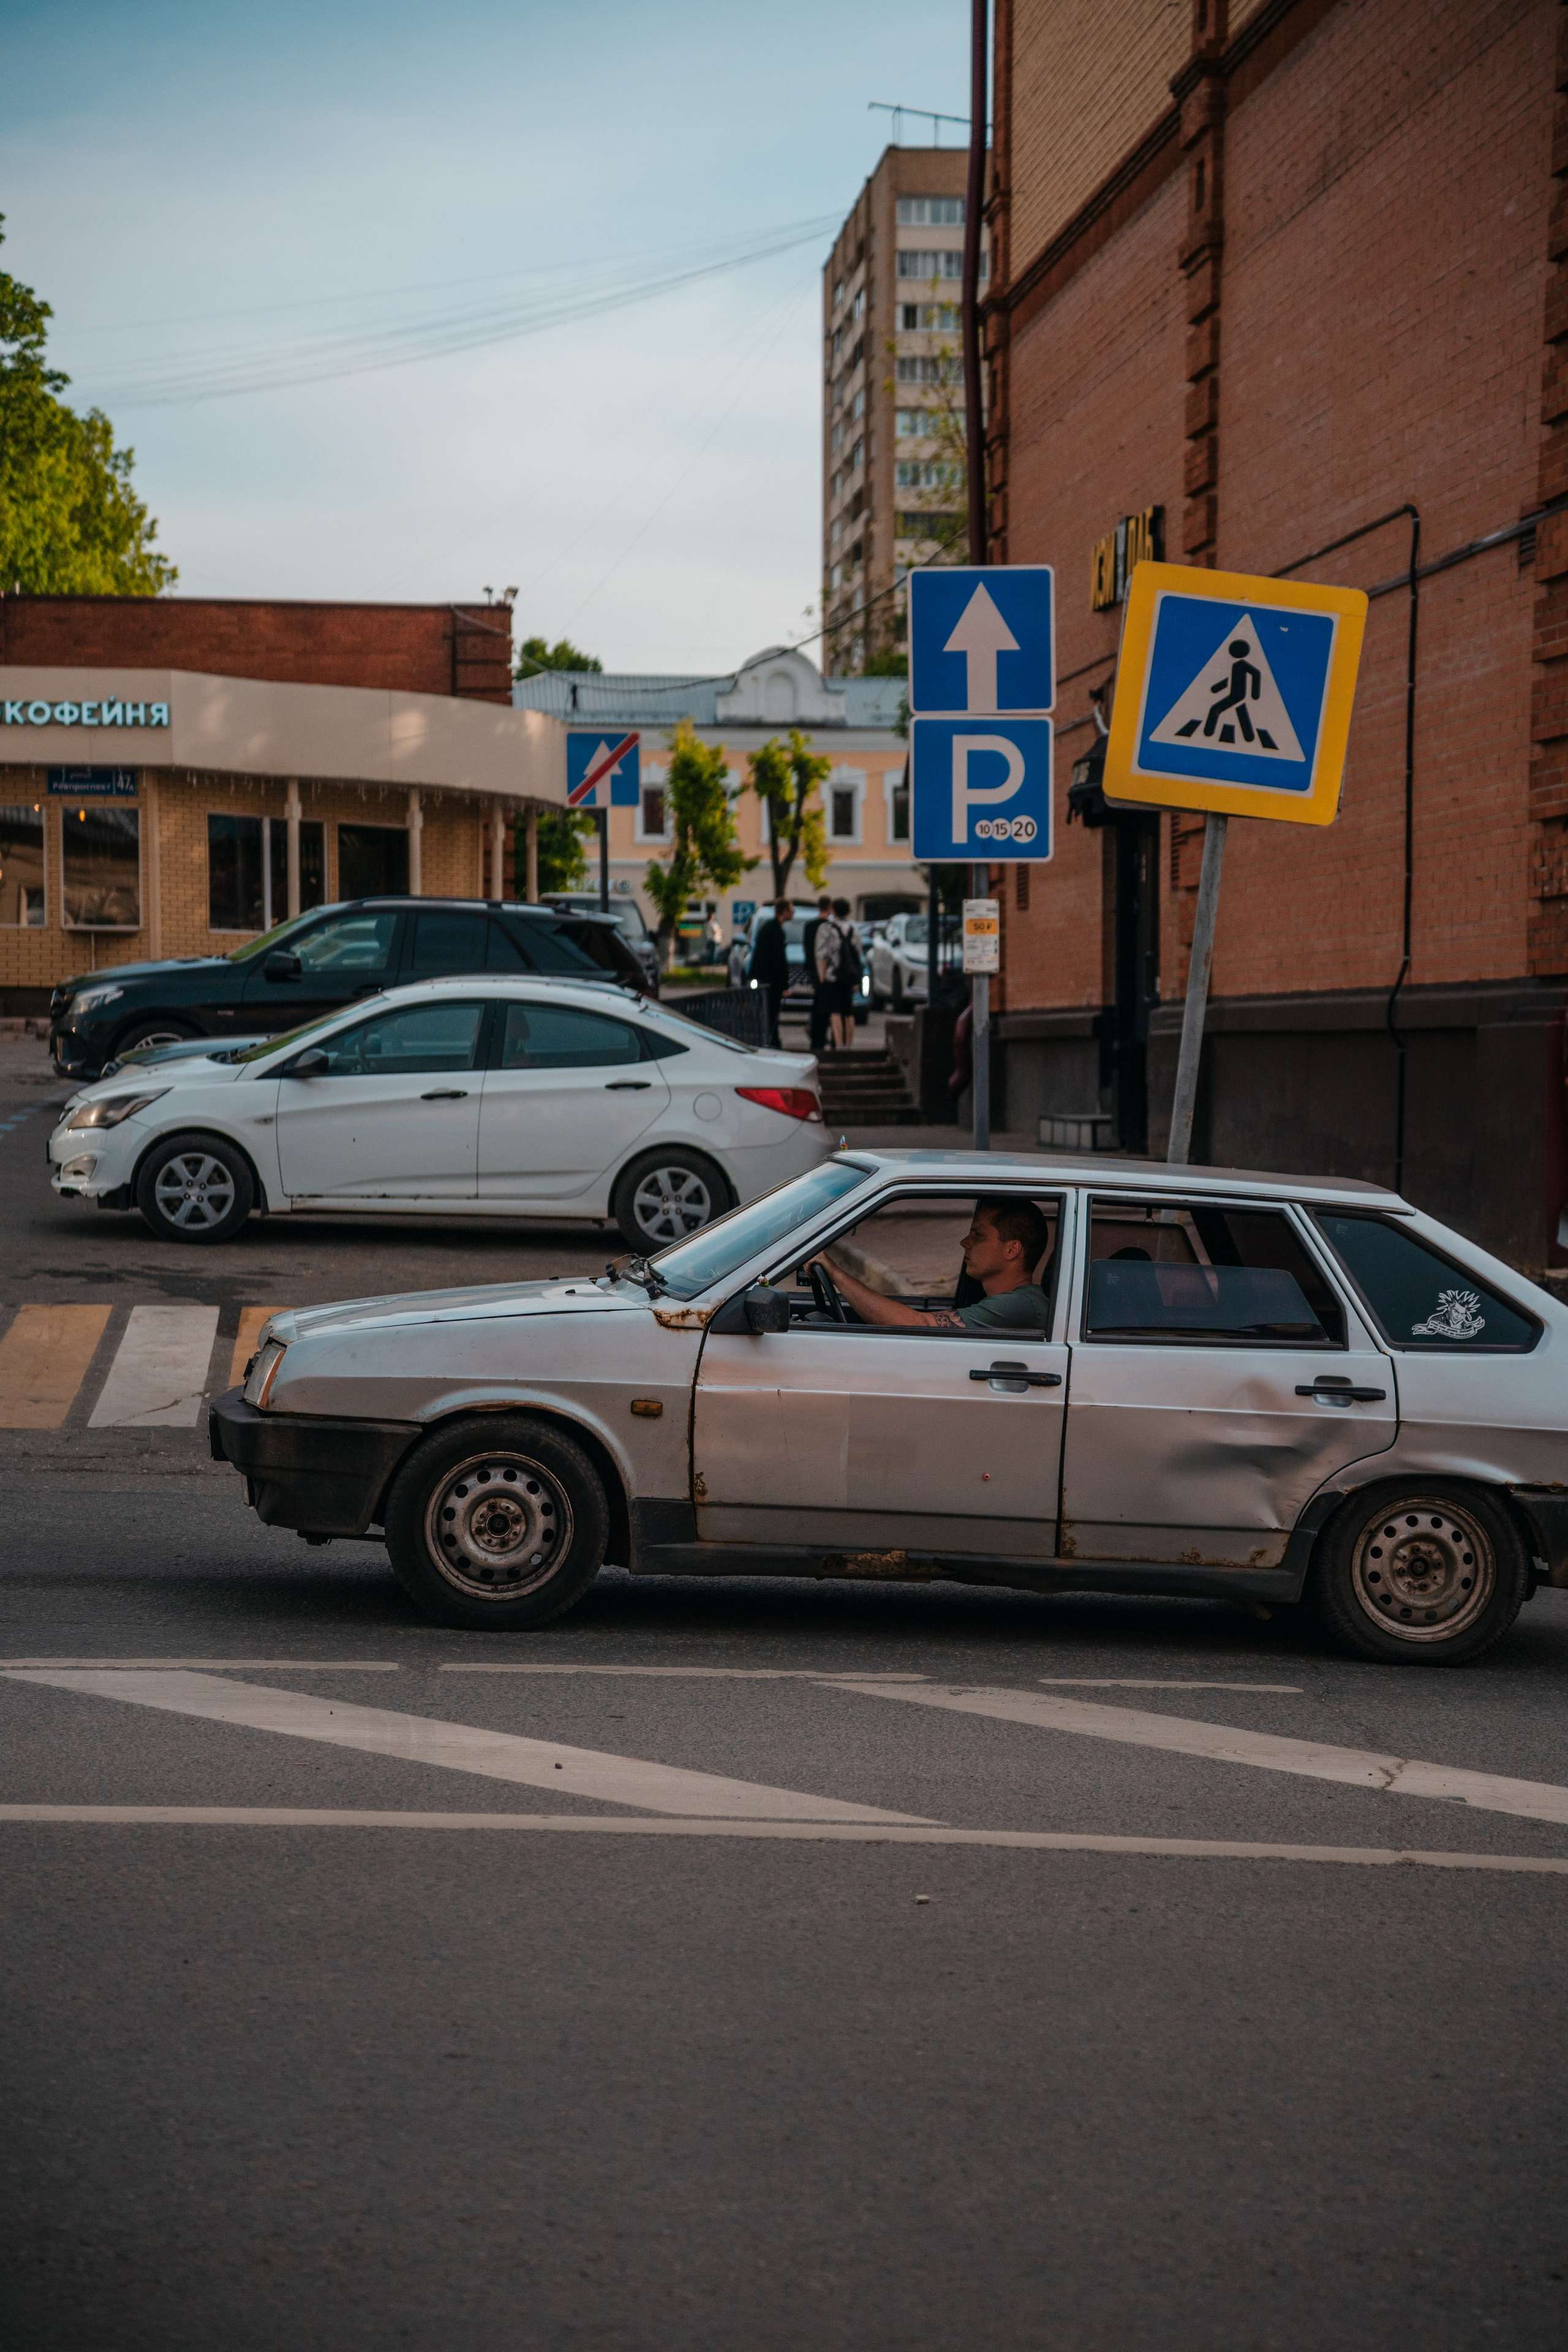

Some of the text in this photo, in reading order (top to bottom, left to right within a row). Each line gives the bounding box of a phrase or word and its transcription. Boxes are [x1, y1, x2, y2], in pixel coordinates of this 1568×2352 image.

[0, 695, 169, 726] КОФЕЙНЯ
[952, 734, 1025, 844] P
[979, 821, 1035, 837] 10 15 20
[974, 922, 985, 930] 50
